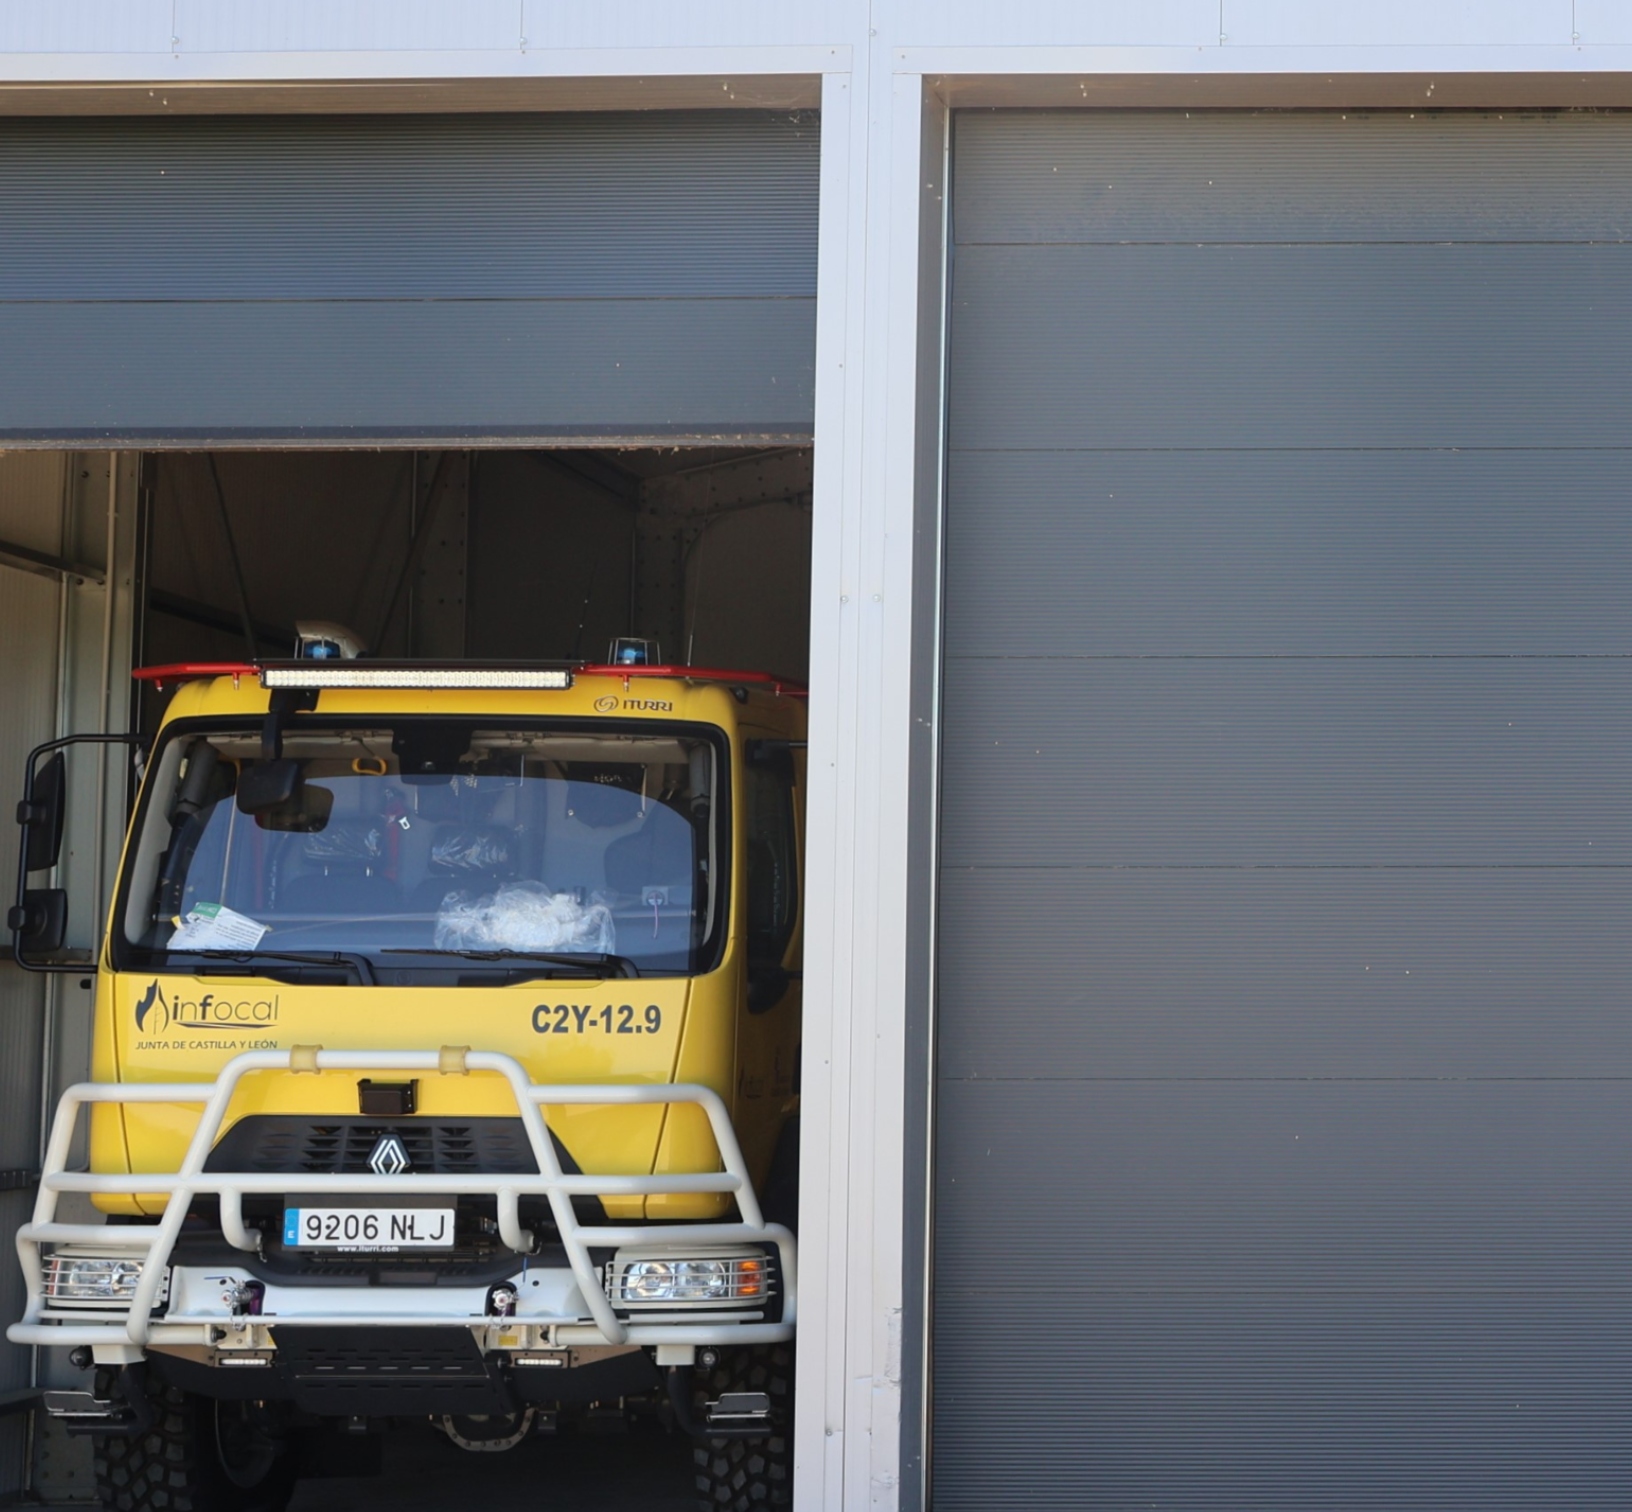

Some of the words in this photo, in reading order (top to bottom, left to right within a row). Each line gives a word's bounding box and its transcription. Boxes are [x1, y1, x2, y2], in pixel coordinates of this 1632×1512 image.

[623, 699, 673, 712] ITURRI
[172, 994, 279, 1021] infocal
[532, 1004, 662, 1034] C2Y-12.9
[135, 1040, 169, 1050] JUNTA
[172, 1040, 186, 1049] DE
[189, 1040, 237, 1049] CASTILLA
[239, 1040, 246, 1049] Y
[248, 1038, 278, 1049] LEÓN
[306, 1214, 379, 1240] 9206
[391, 1214, 445, 1240] NLJ
[337, 1245, 399, 1253] www.iturri.com
